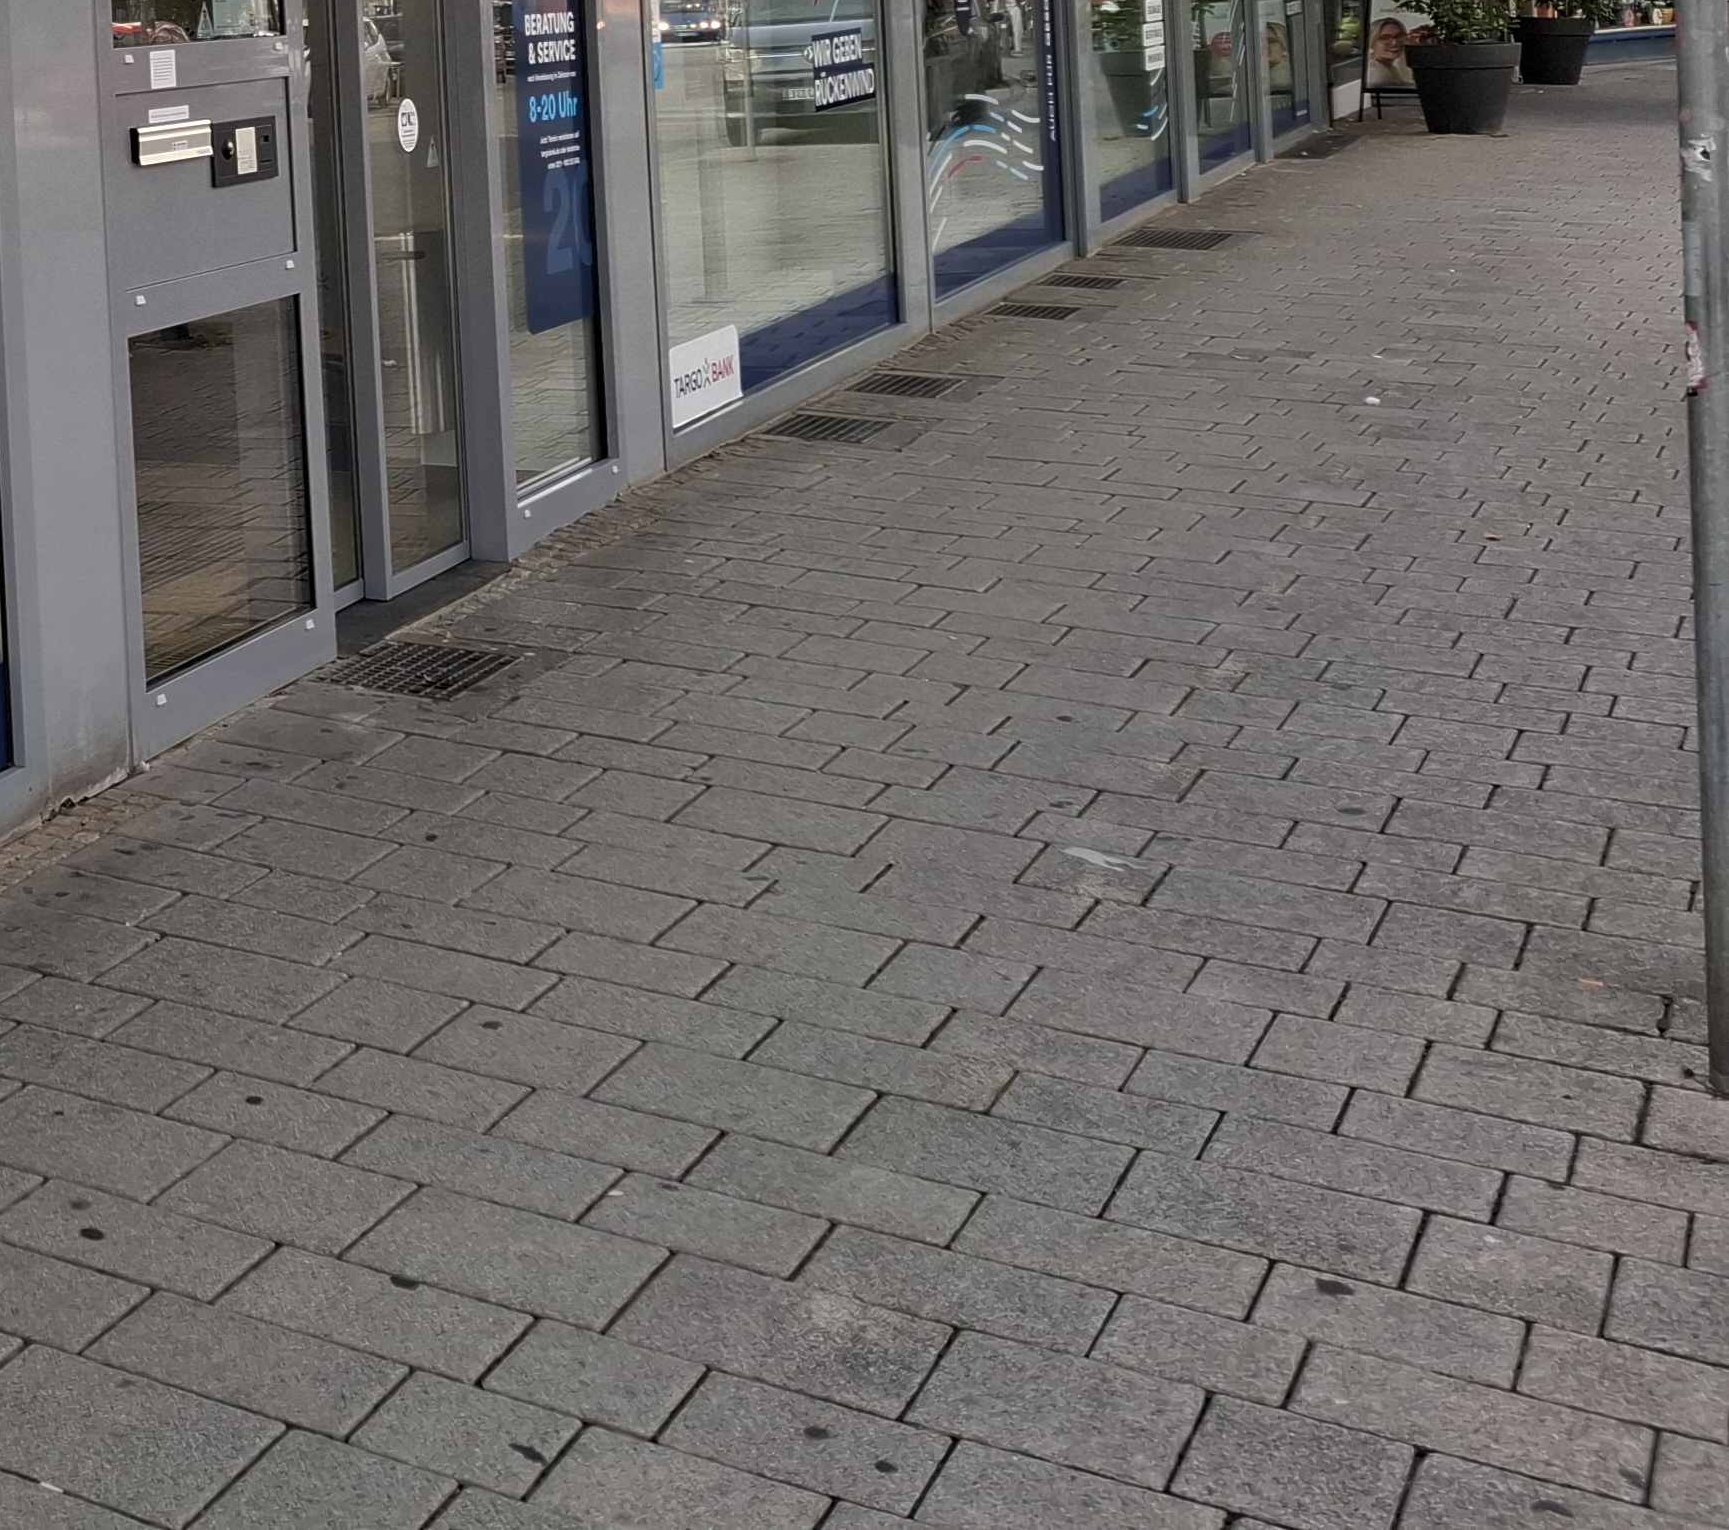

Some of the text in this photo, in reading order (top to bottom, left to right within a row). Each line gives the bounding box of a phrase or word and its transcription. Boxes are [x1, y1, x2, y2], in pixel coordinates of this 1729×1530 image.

[524, 11, 575, 37] BERATUNG
[528, 39, 576, 65] & SERVICE
[812, 34, 862, 67] WIR GEBEN
[815, 68, 875, 106] RÜCKENWIND
[529, 90, 577, 122] 8-20 Uhr
[674, 354, 735, 399] TARGO BANK
